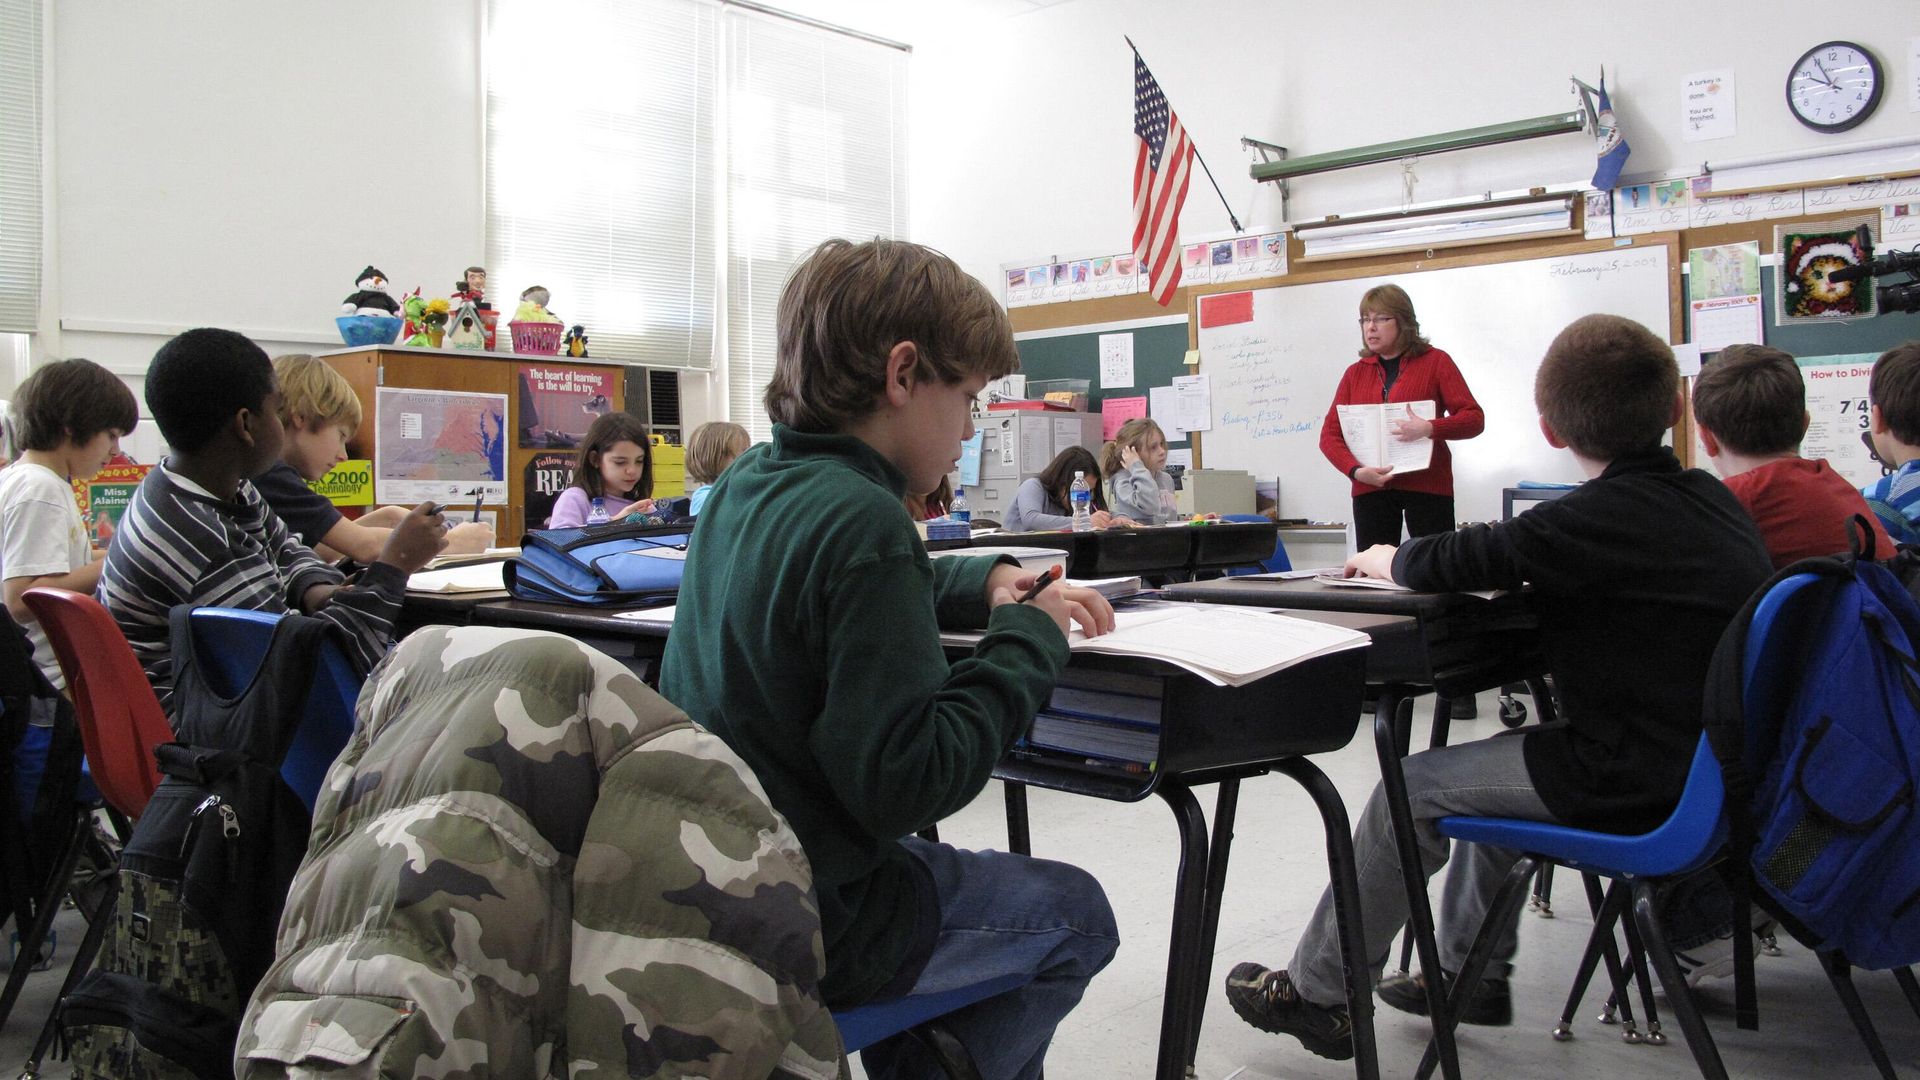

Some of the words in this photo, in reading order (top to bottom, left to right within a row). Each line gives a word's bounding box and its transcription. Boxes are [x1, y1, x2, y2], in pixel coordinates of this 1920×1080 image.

[1828, 52, 1837, 61] 12
[1802, 71, 1811, 80] 10
[1803, 98, 1809, 106] 8
[1856, 93, 1862, 101] 4
[1815, 108, 1821, 116] 7
[1829, 111, 1836, 119] 6
[1846, 105, 1852, 113] 5
[1550, 262, 1601, 280] February
[530, 369, 543, 379] The
[545, 370, 563, 381] heart
[565, 371, 572, 380] of
[574, 372, 602, 386] learning
[1811, 371, 1833, 379] How
[1836, 369, 1848, 378] to
[1851, 368, 1872, 377] Divi
[538, 380, 544, 390] is
[546, 380, 558, 390] the
[559, 382, 572, 392] will
[574, 383, 581, 392] to
[582, 384, 594, 395] try.
[1840, 400, 1851, 414] 7
[1857, 399, 1869, 413] 4
[1222, 411, 1249, 431] Reading
[1859, 415, 1870, 428] 3
[536, 456, 561, 468] Follow
[564, 460, 576, 469] my
[328, 471, 369, 484] 2000
[536, 469, 574, 495] REA
[104, 488, 127, 496] Miss
[314, 482, 362, 495] Technology
